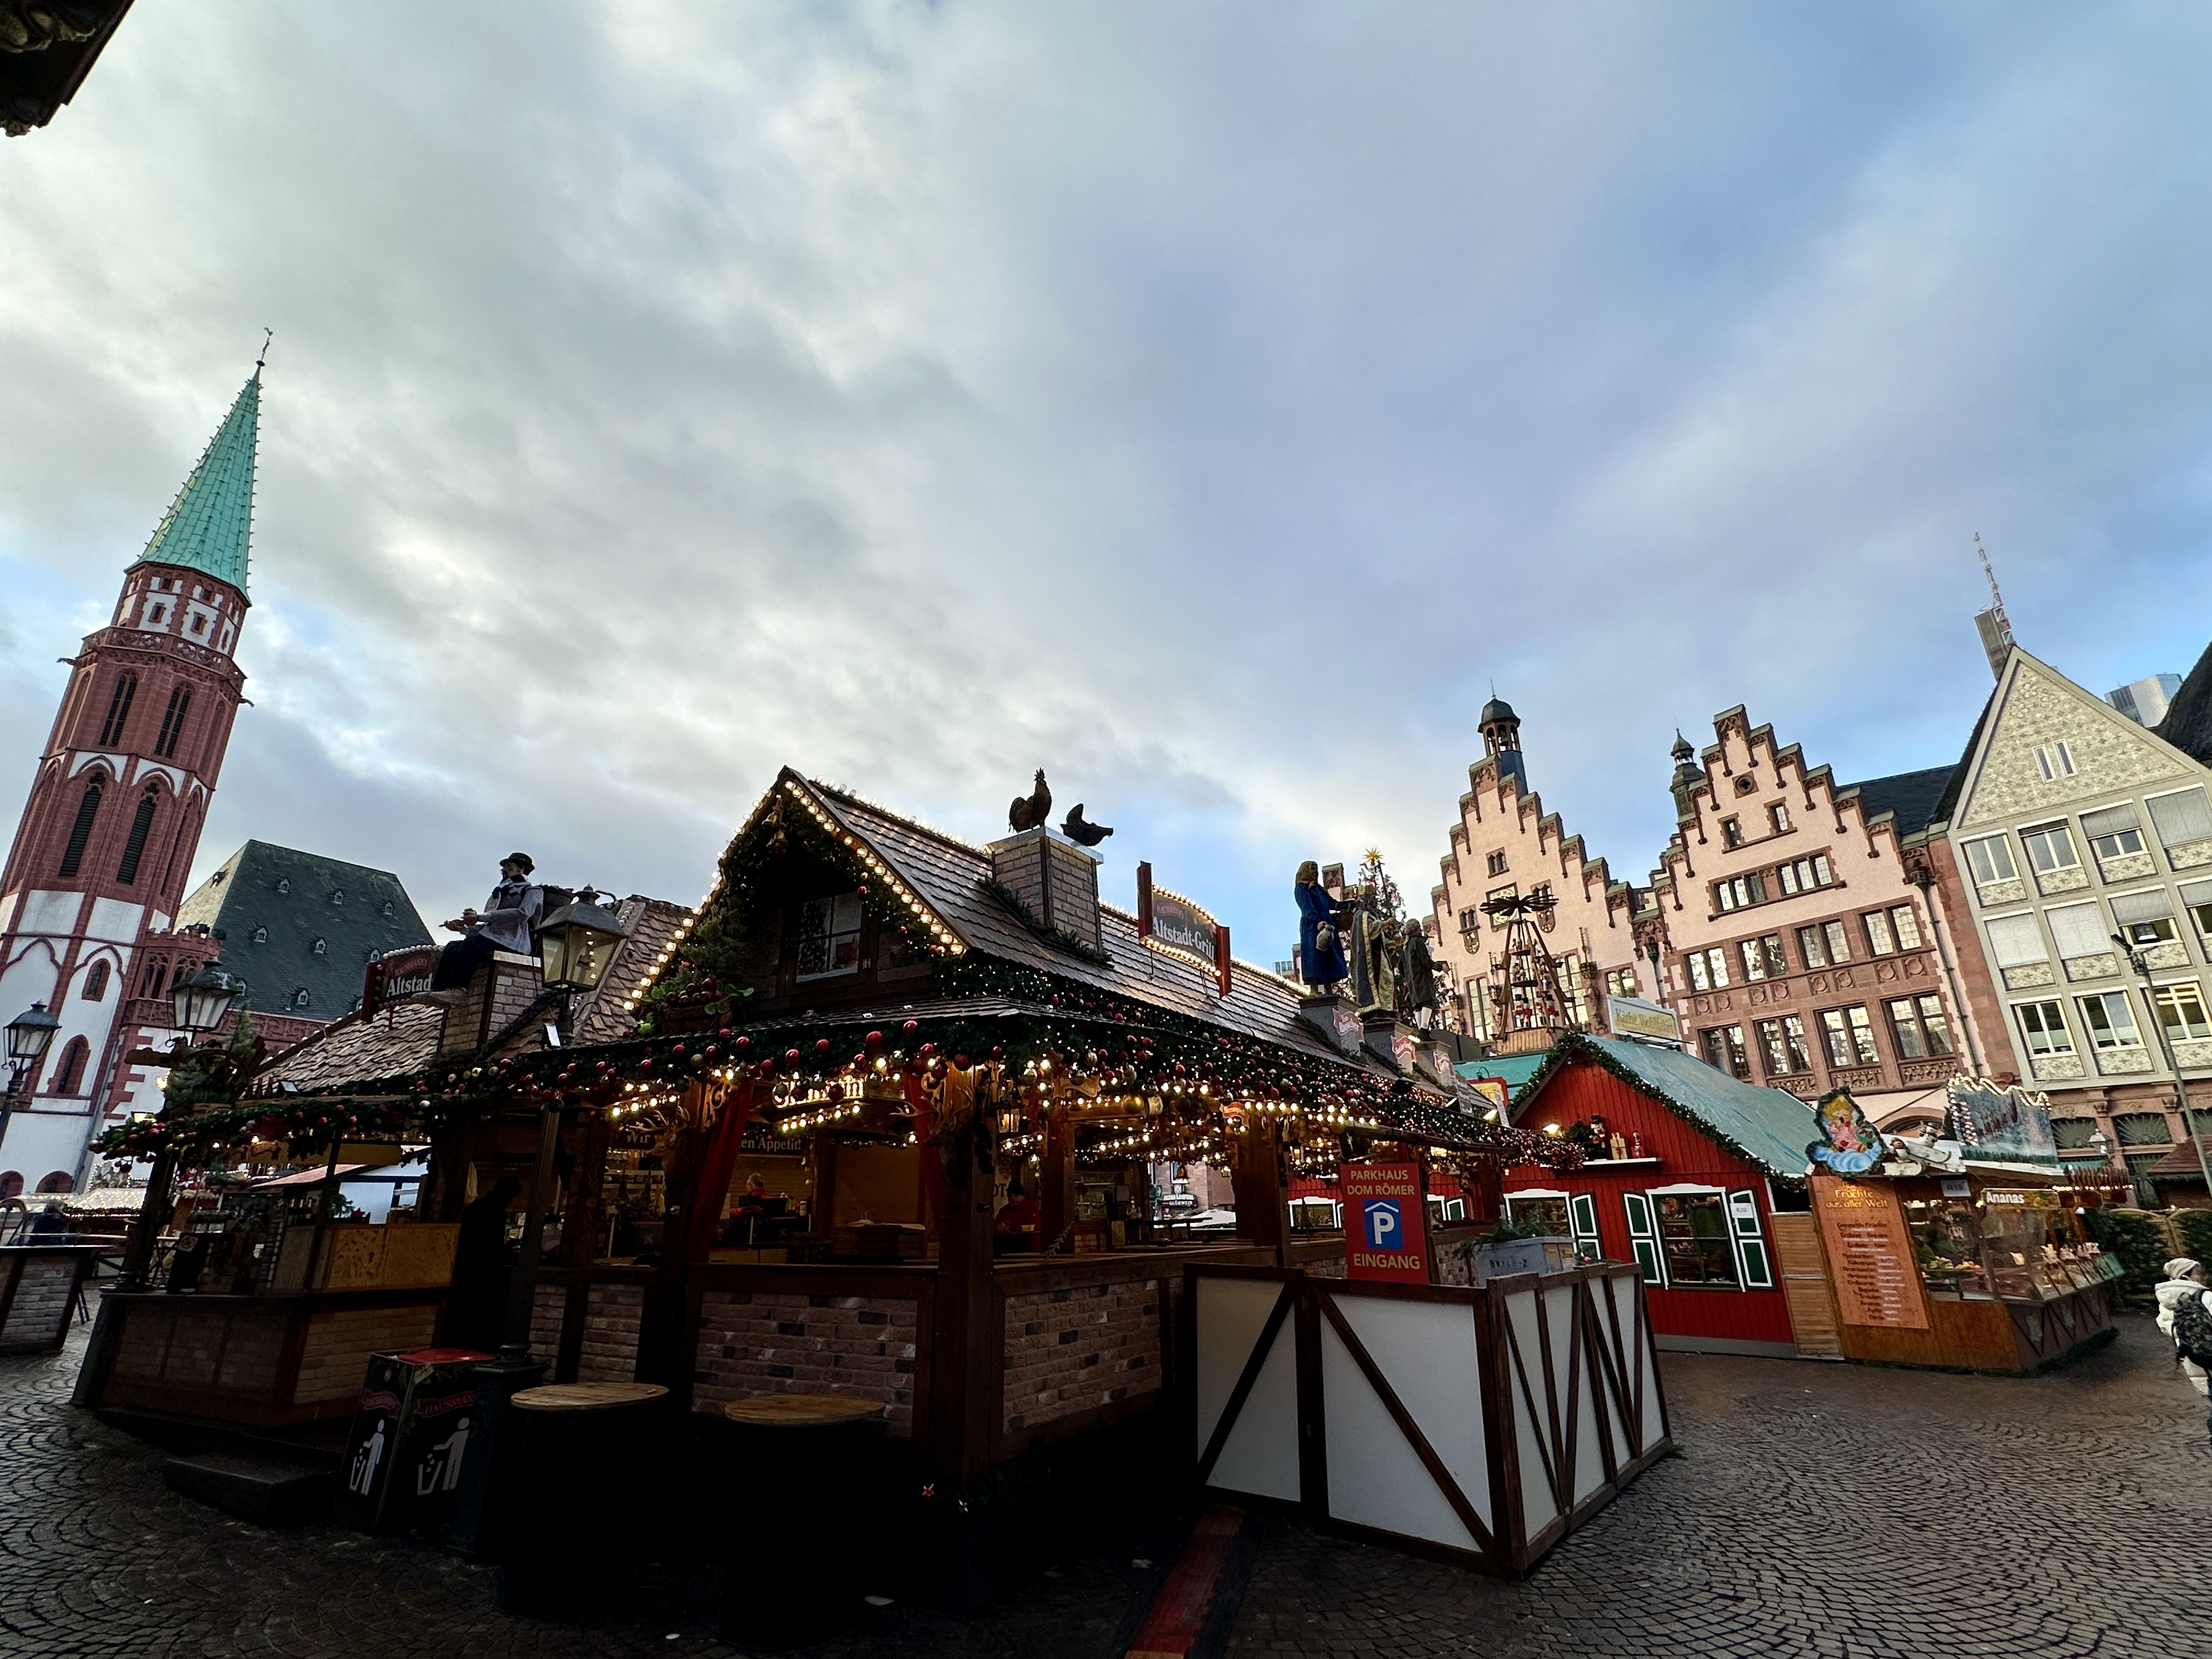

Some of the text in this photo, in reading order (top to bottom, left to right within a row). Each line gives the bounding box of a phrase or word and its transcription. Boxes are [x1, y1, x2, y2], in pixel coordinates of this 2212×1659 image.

[1153, 916, 1215, 962] Altstadt-Grill
[1615, 1008, 1674, 1034] Käthe Wohlfahrt
[757, 1137, 801, 1152] Appetit!
[1351, 1170, 1408, 1180] PARKHAUS
[1347, 1183, 1415, 1195] DOM RÖMER
[1843, 1199, 1863, 1208] aller
[1865, 1199, 1888, 1208] Welt
[1986, 1192, 2024, 1204] Ananas
[1373, 1211, 1395, 1244] P
[1353, 1253, 1420, 1269] EINGANG
